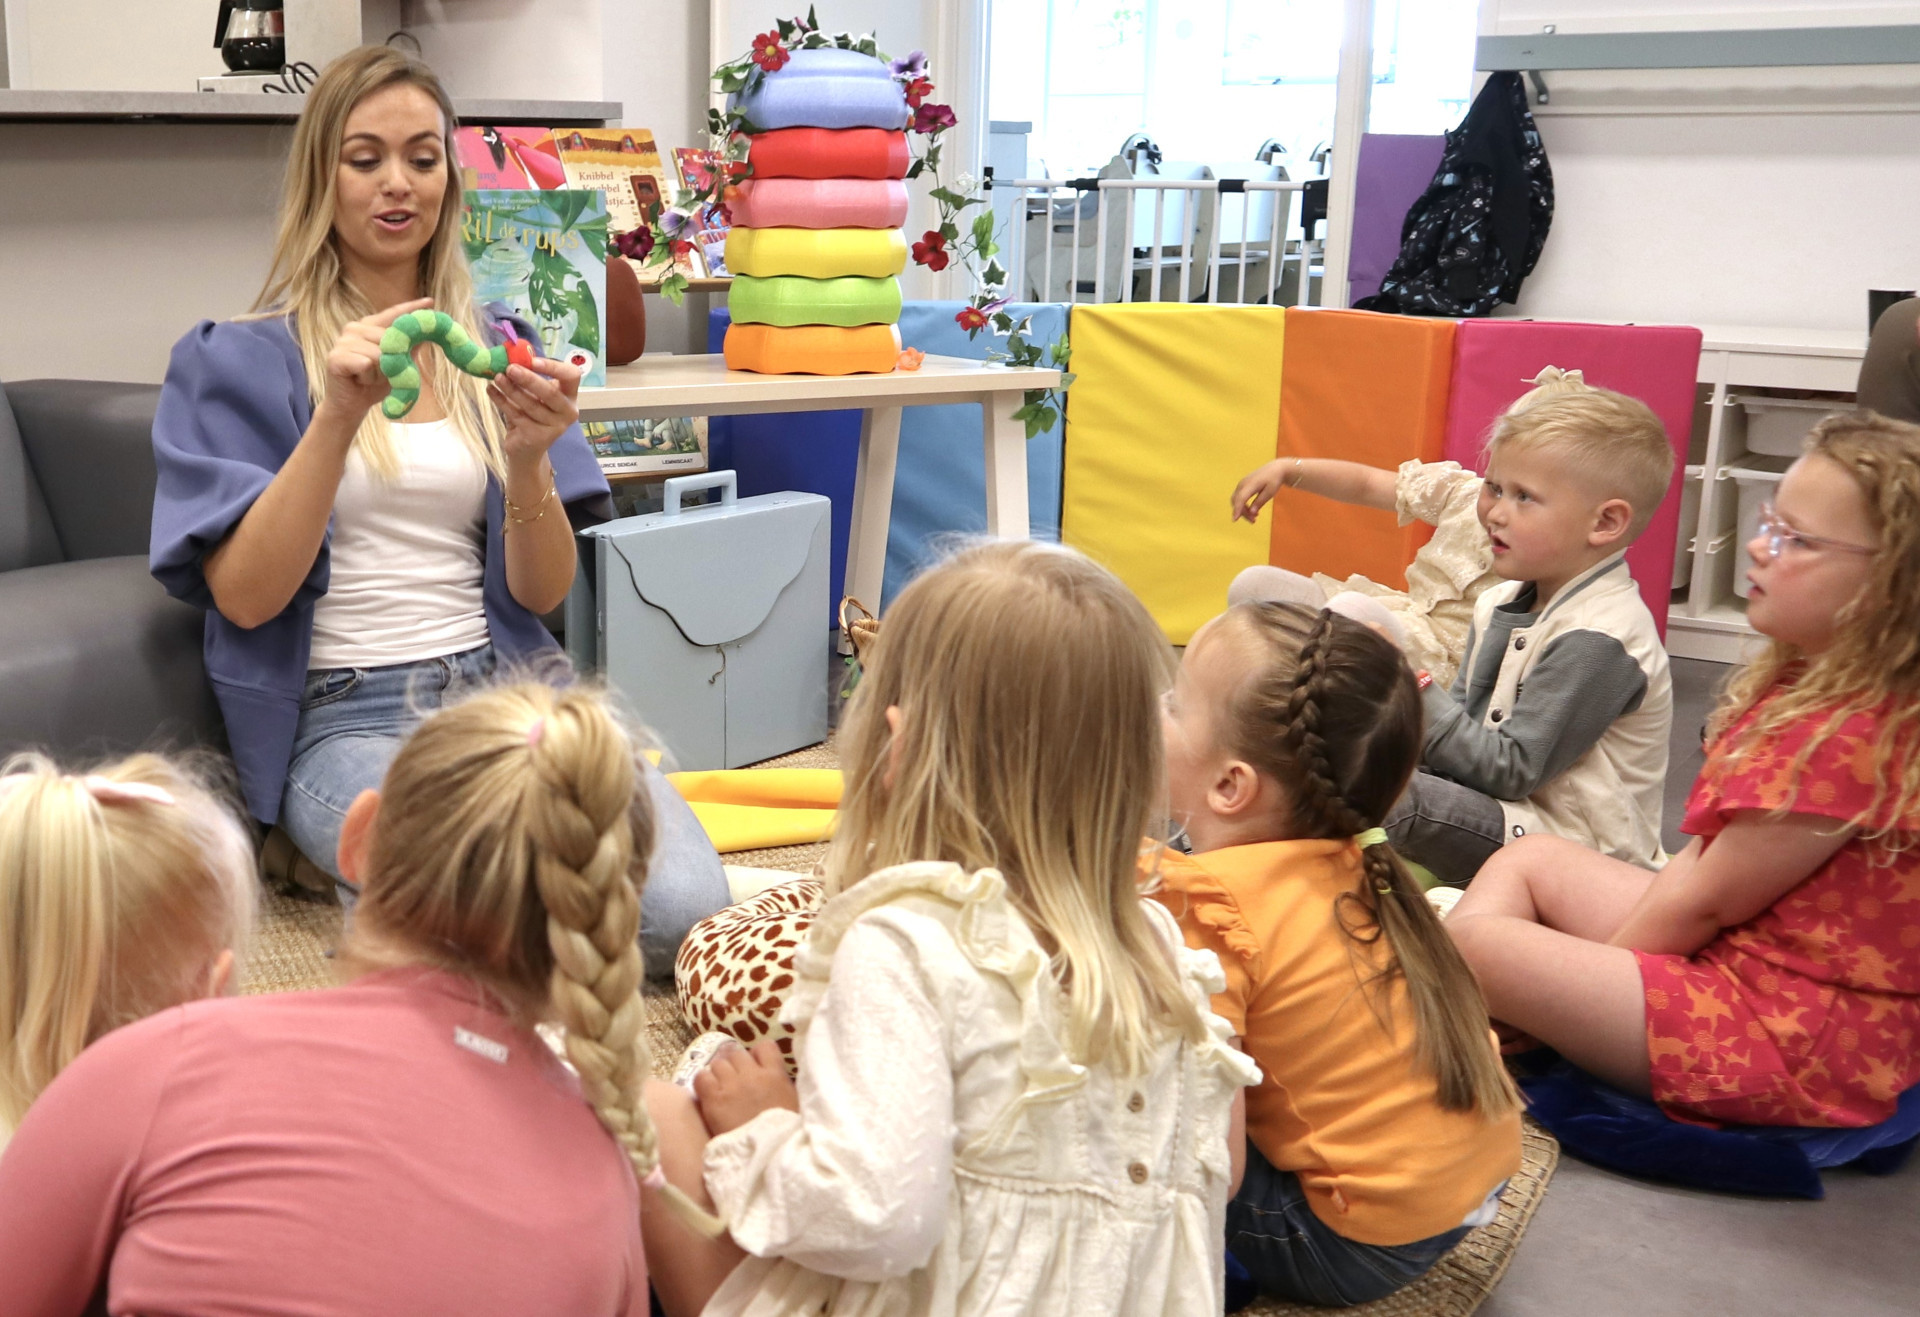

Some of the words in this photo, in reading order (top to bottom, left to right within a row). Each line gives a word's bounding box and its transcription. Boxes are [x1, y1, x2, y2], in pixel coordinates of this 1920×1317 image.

[579, 171, 614, 181] Knibbel
[605, 197, 631, 208] istje...
[499, 221, 516, 239] de
[522, 229, 579, 258] rups
